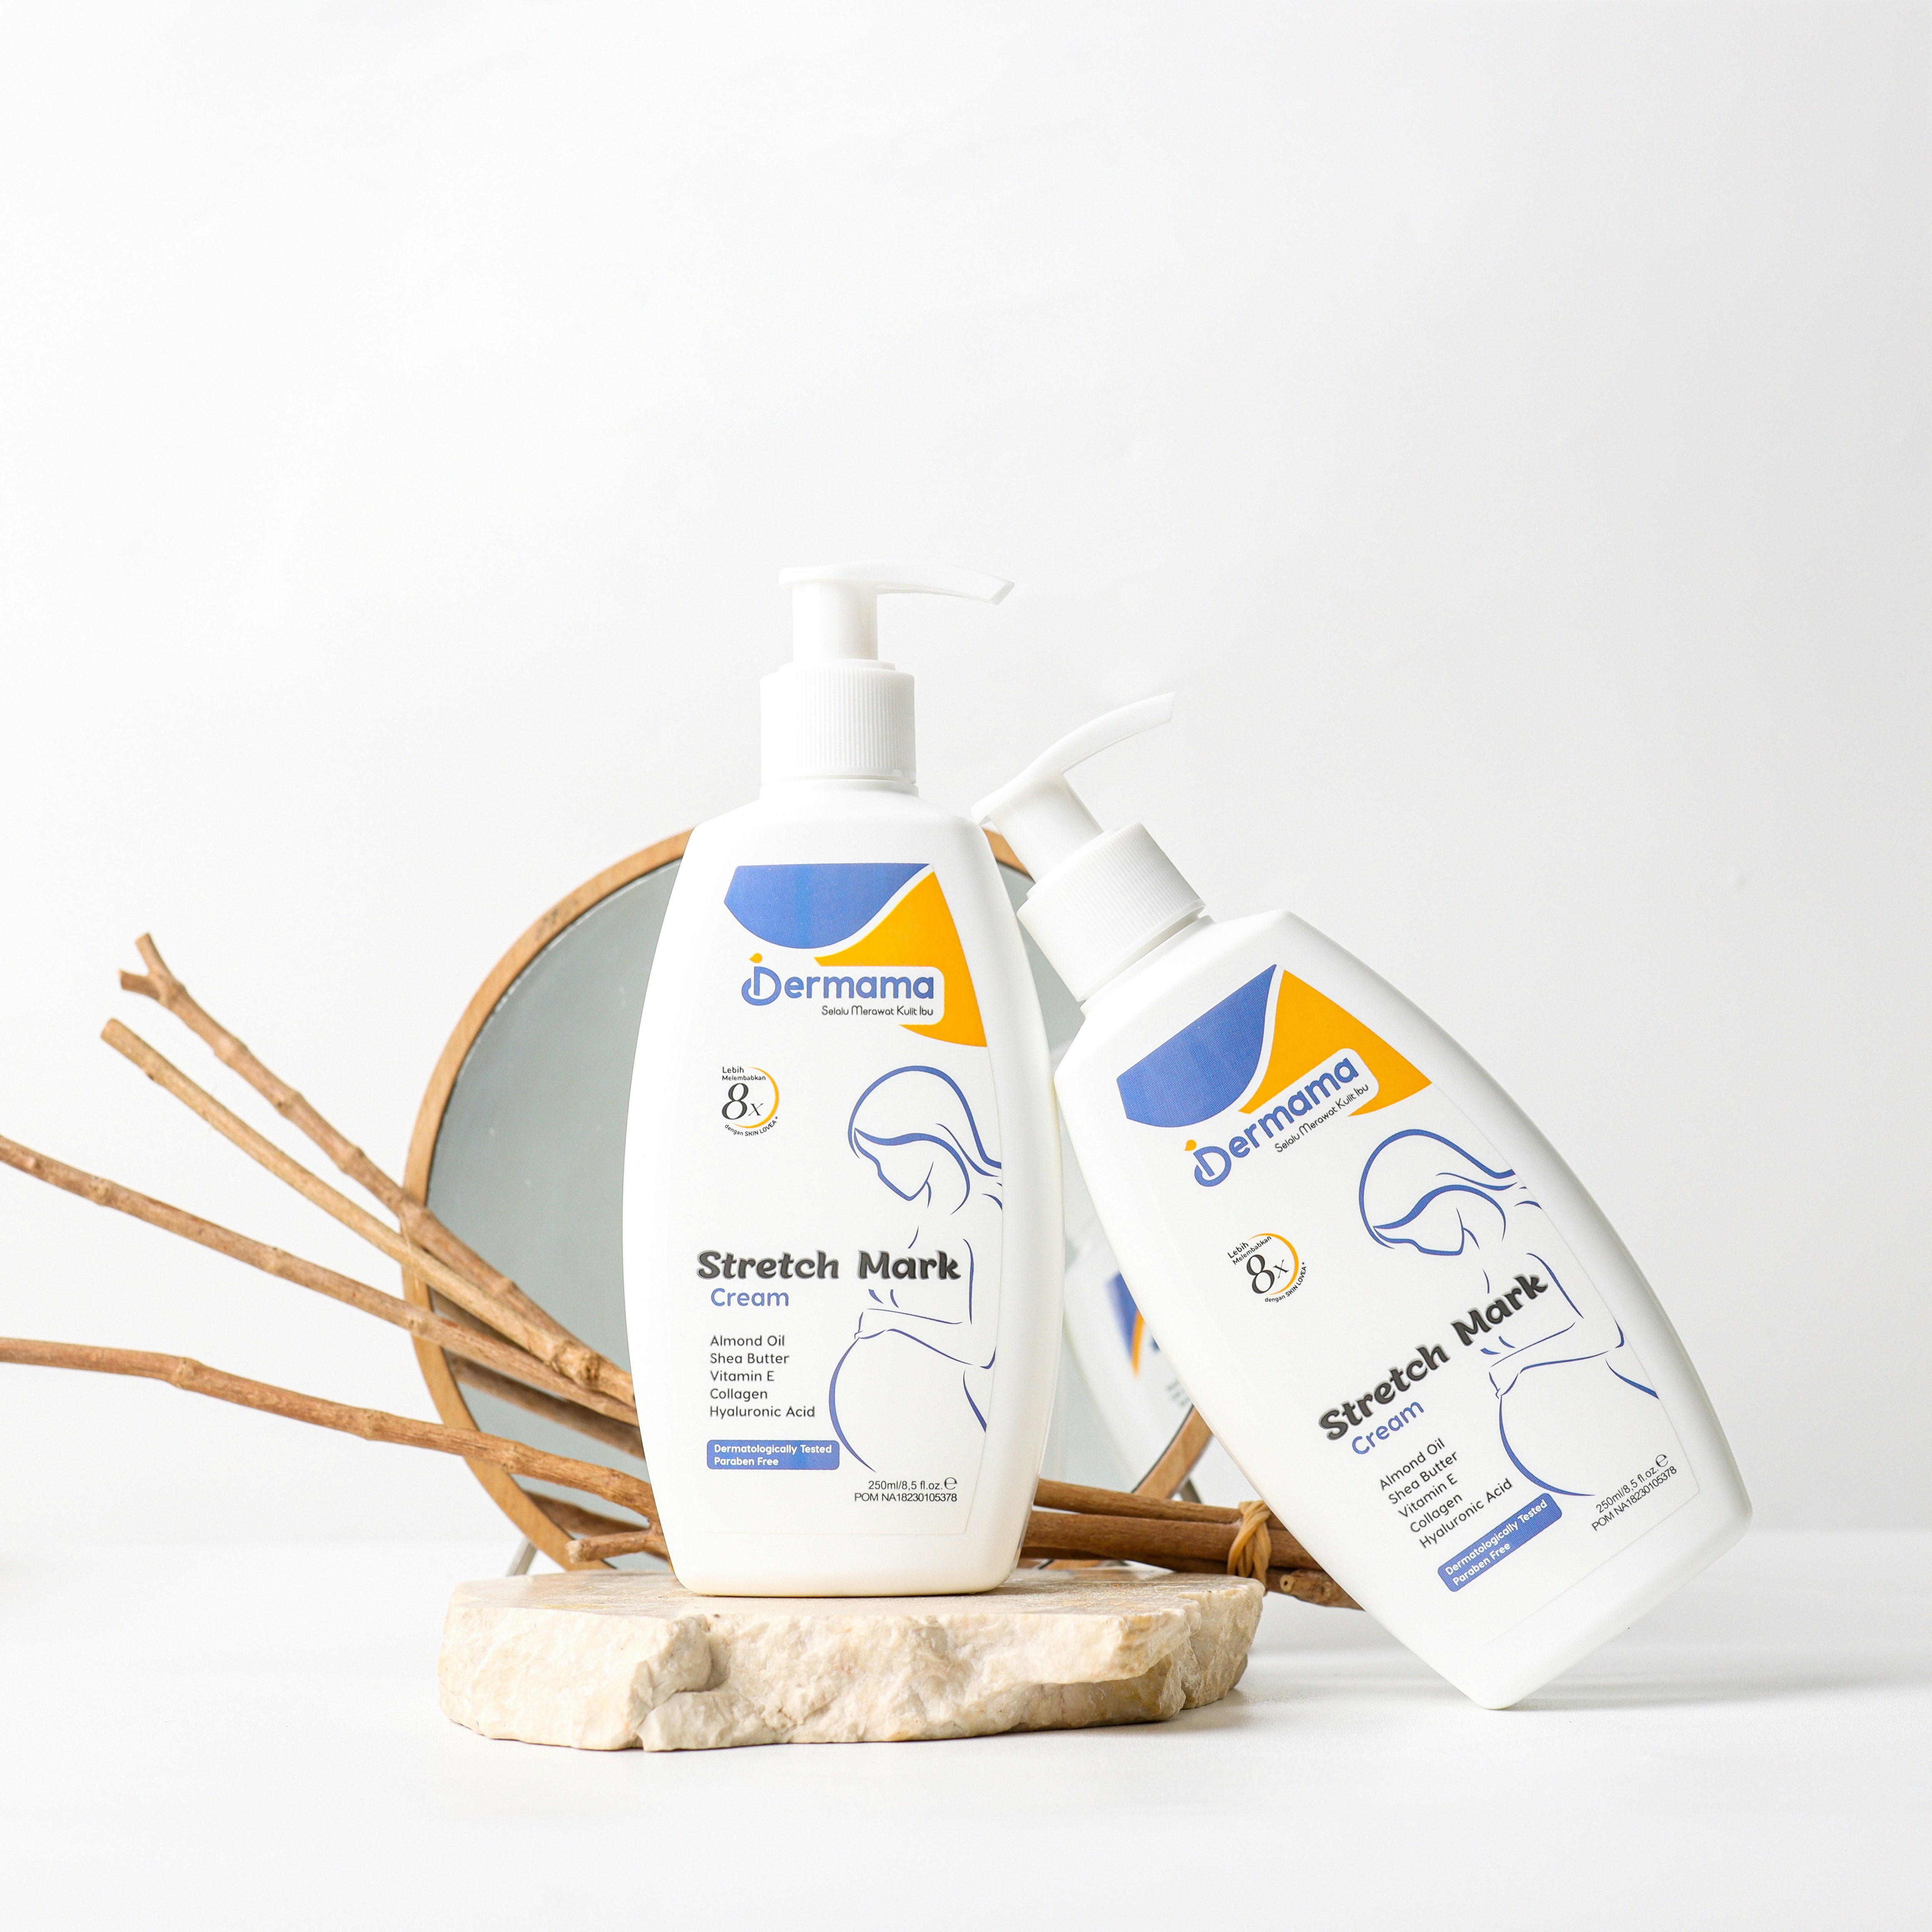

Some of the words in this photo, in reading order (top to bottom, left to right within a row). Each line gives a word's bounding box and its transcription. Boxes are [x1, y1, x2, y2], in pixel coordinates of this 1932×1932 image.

[822, 1005, 849, 1015] Selalu
[851, 1005, 894, 1015] Merawat
[897, 1005, 917, 1015] Kulit
[919, 1005, 934, 1016] Ibu
[725, 1125, 743, 1135] dengan
[759, 1120, 777, 1134] LOVEA
[1275, 1133, 1300, 1153] Selalu
[1299, 1107, 1338, 1136] Merawat
[1335, 1093, 1356, 1109] Kulit
[1353, 1084, 1369, 1097] Ibu
[697, 1250, 839, 1280] Stretch
[857, 1250, 961, 1280] Mark
[1227, 1242, 1249, 1259] Lebih
[1232, 1236, 1272, 1265] Melembabkan
[1285, 1285, 1298, 1297] SKIN
[1296, 1266, 1307, 1285] LOVEA
[710, 1287, 789, 1307] Cream
[710, 1335, 762, 1346] Almond
[767, 1335, 784, 1346] Oil
[710, 1353, 742, 1364] Shea
[748, 1353, 789, 1364] Butter
[1318, 1343, 1451, 1441] Stretch
[1450, 1273, 1548, 1347] Mark
[710, 1370, 762, 1382] Vitamin
[767, 1371, 774, 1382] E
[710, 1388, 767, 1402] Collagen
[710, 1406, 782, 1419] Hyaluronic
[786, 1406, 815, 1417] Acid
[1352, 1401, 1424, 1455] Cream
[714, 1444, 797, 1455] Dermatologically
[800, 1444, 832, 1453] Tested
[714, 1457, 754, 1466] Paraben
[757, 1457, 779, 1466] Free
[1379, 1451, 1427, 1491] Almond
[1427, 1437, 1446, 1454] Oil
[868, 1481, 917, 1491] 250ml/8,5
[1388, 1480, 1420, 1505] Shea
[1420, 1451, 1458, 1482] Butter
[854, 1493, 878, 1501] POM
[882, 1493, 957, 1501] NA18230105378
[1398, 1482, 1447, 1518] Vitamin
[1447, 1473, 1458, 1486] E
[1591, 1511, 1615, 1531] POM
[1614, 1466, 1677, 1515] NA18230105378
[1596, 1479, 1638, 1513] 250ml/8,5
[1410, 1494, 1463, 1533] Collagen
[1419, 1500, 1484, 1549] Hyaluronic
[1486, 1478, 1513, 1504] Acid
[1445, 1521, 1519, 1576] Dermatologically
[1517, 1499, 1548, 1524] Tested
[1452, 1557, 1490, 1586] Paraben
[1490, 1543, 1511, 1560] Free
